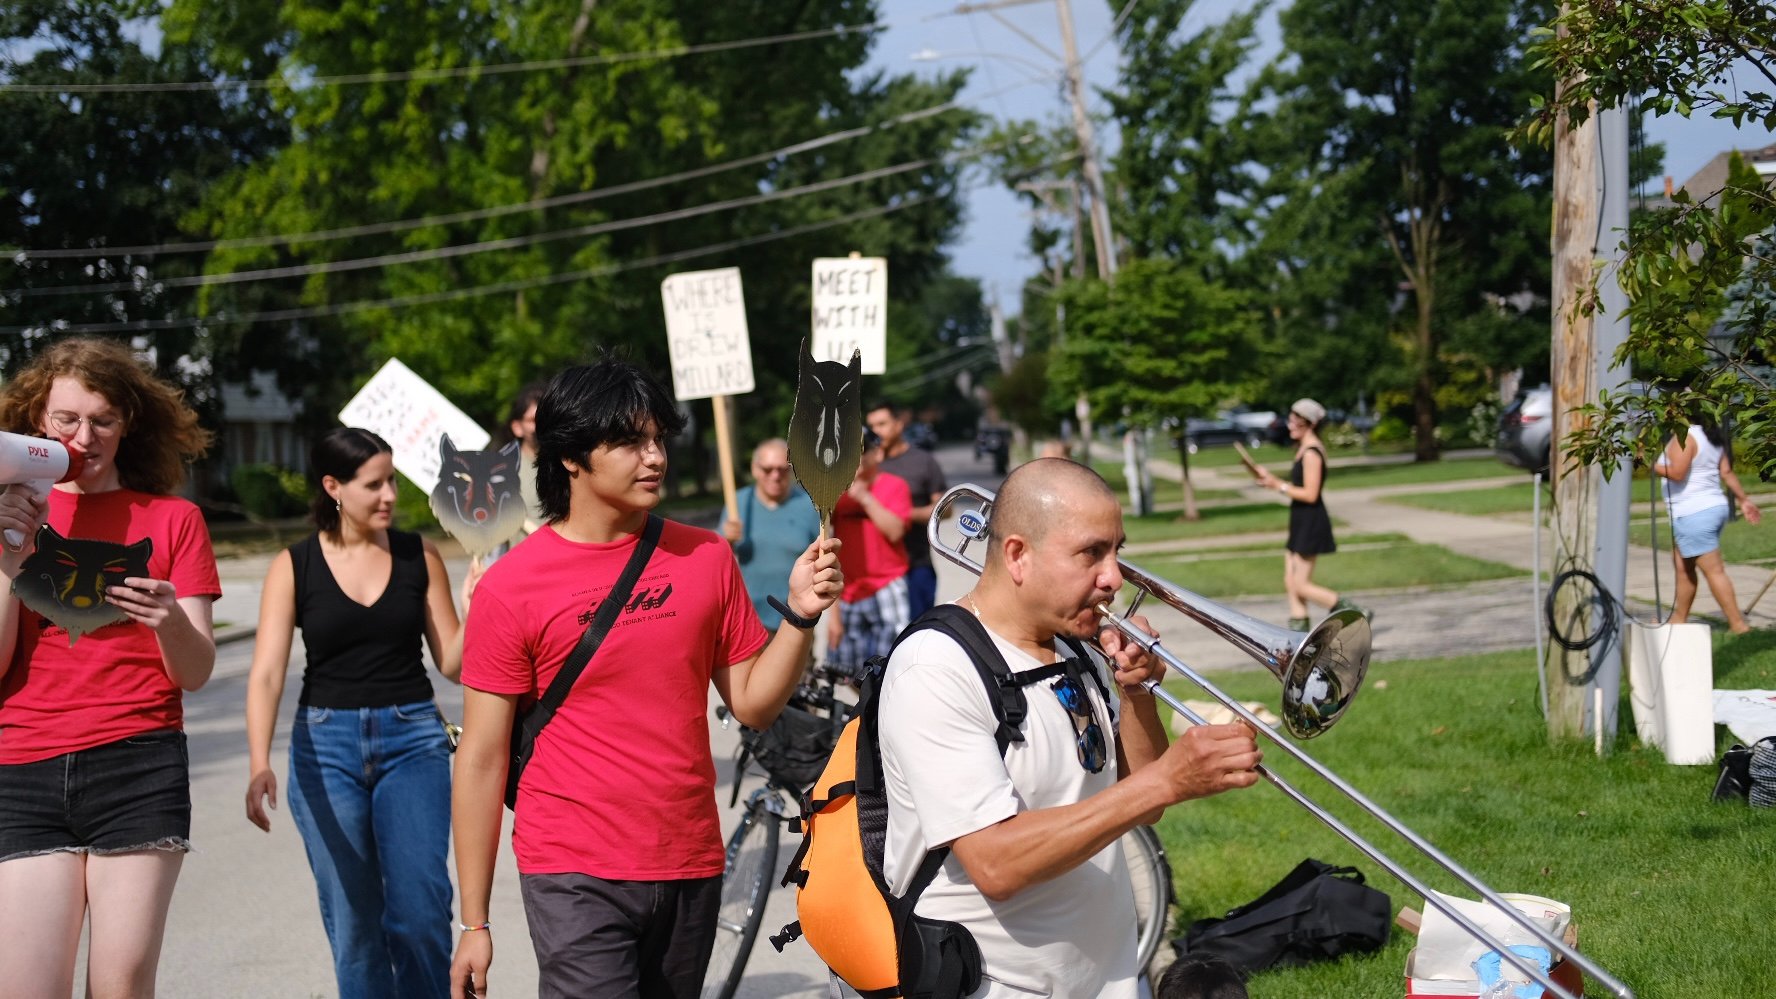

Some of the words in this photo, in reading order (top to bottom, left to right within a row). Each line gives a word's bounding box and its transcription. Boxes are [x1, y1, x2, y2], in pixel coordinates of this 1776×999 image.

[667, 272, 737, 311] WHERE
[818, 267, 877, 297] MEET
[689, 311, 717, 333] IS
[815, 304, 878, 329] WITH
[674, 333, 740, 361] DREW
[28, 446, 49, 458] PYLE
[961, 516, 982, 531] OLDS
[622, 616, 647, 627] TENANT
